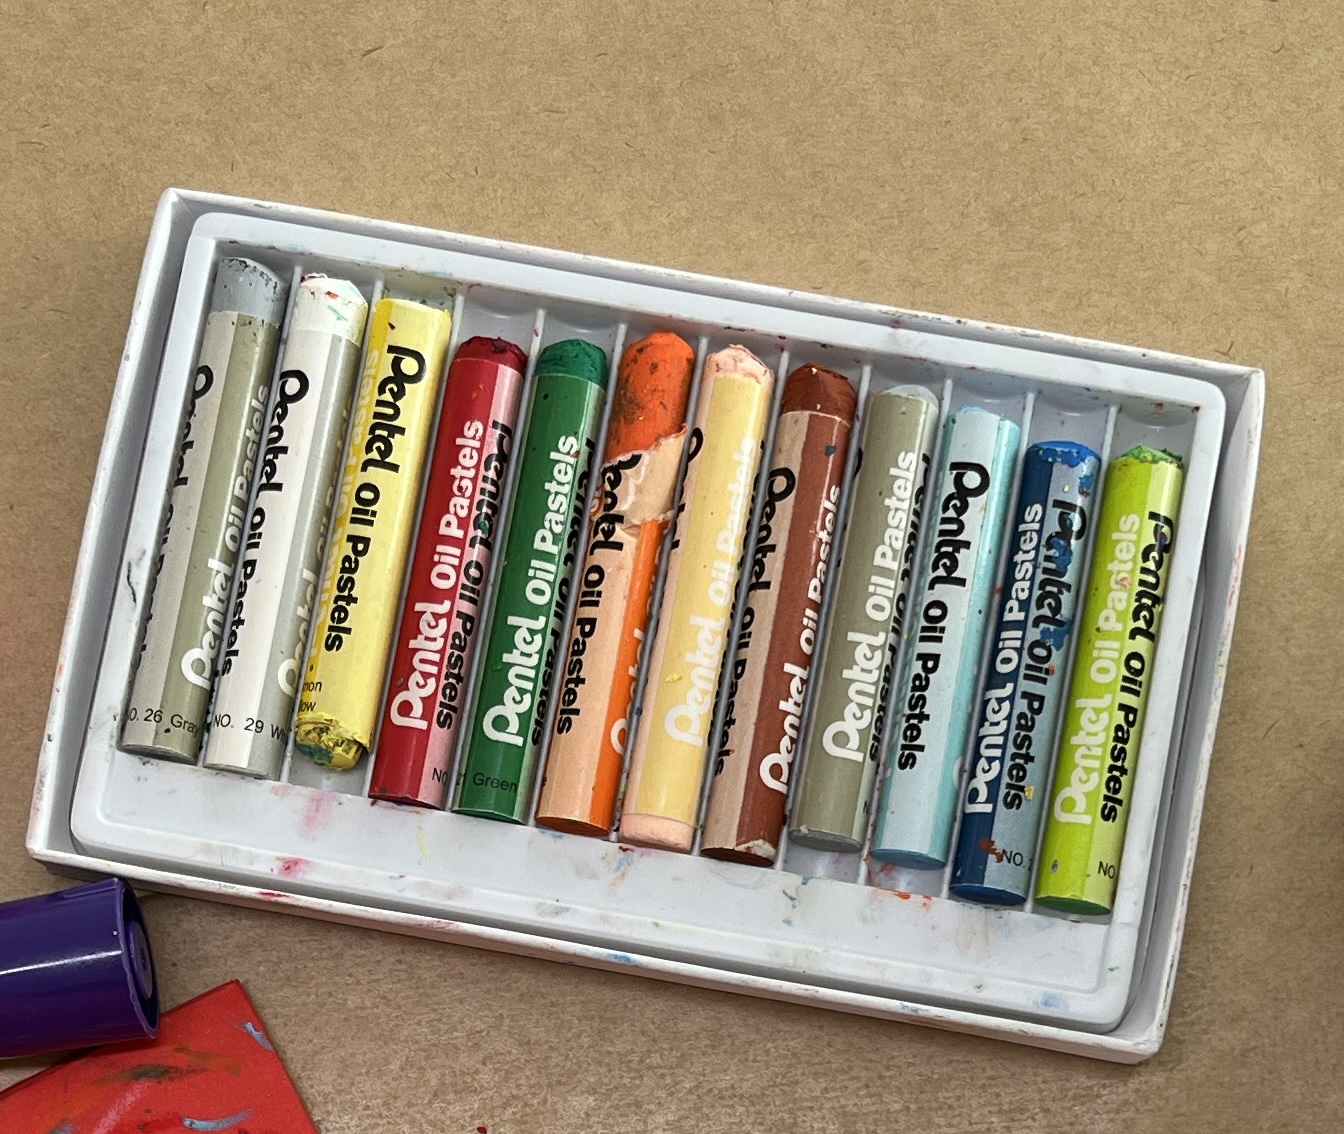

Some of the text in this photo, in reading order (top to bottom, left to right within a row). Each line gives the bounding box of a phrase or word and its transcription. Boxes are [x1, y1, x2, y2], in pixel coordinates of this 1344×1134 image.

[360, 344, 426, 474] Pentel
[390, 599, 451, 730] Pentel
[438, 419, 484, 539] Pastels
[927, 461, 990, 591] Pentel
[1128, 511, 1174, 642] Pentel
[221, 559, 257, 676] Pastels
[325, 534, 372, 652] Pastels
[482, 615, 546, 747] Pentel
[533, 434, 578, 555] Pastels
[822, 631, 887, 763] Pentel
[873, 450, 916, 572] Pastels
[143, 708, 163, 724] 26
[436, 609, 476, 731] Pastels
[556, 617, 598, 735] Pastels
[664, 615, 726, 747] Pentel
[897, 652, 942, 771] Pastels
[964, 682, 1014, 814] Pentel
[1003, 503, 1043, 623] Pastels
[1054, 693, 1112, 825] Pentel
[1097, 512, 1141, 633] Pastels
[244, 717, 264, 734] 29
[472, 772, 518, 793] Green
[759, 662, 810, 795] Pentel
[1003, 689, 1045, 811] Pastels
[1100, 702, 1138, 824] Pastels
